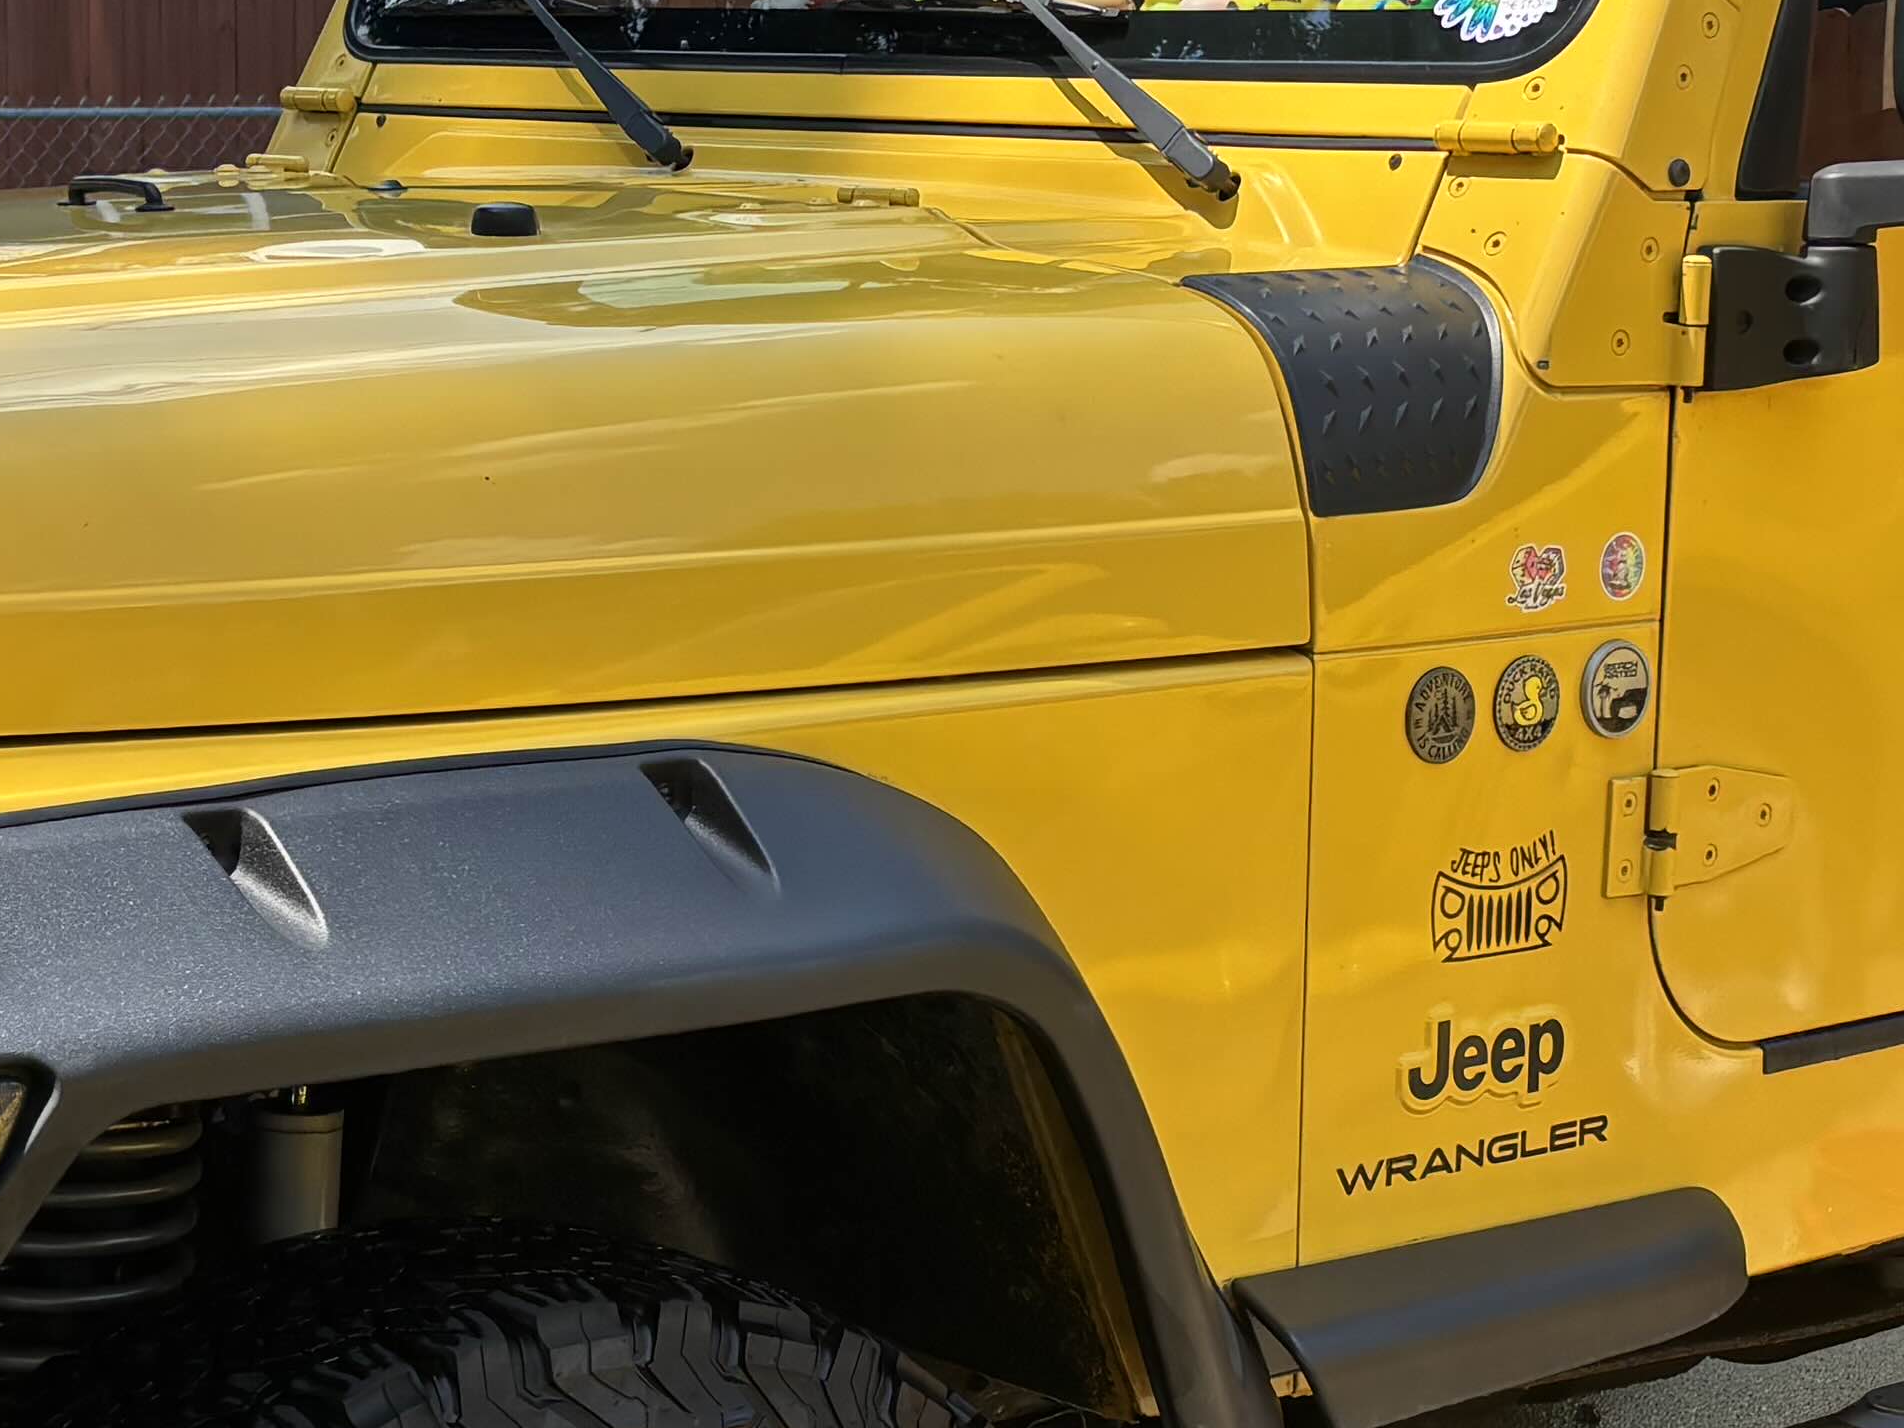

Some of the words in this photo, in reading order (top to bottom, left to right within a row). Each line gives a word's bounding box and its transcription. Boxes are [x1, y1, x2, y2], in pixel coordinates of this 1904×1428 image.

[1507, 585, 1532, 605] Las
[1533, 581, 1564, 607] Vegas
[1414, 672, 1472, 713] ADVENTURE
[1503, 667, 1528, 704] DUCK
[1450, 847, 1501, 883] JEEPS
[1509, 829, 1557, 877] ONLY!
[1408, 1018, 1565, 1101] Jeep
[1336, 1115, 1609, 1196] WRANGLER
